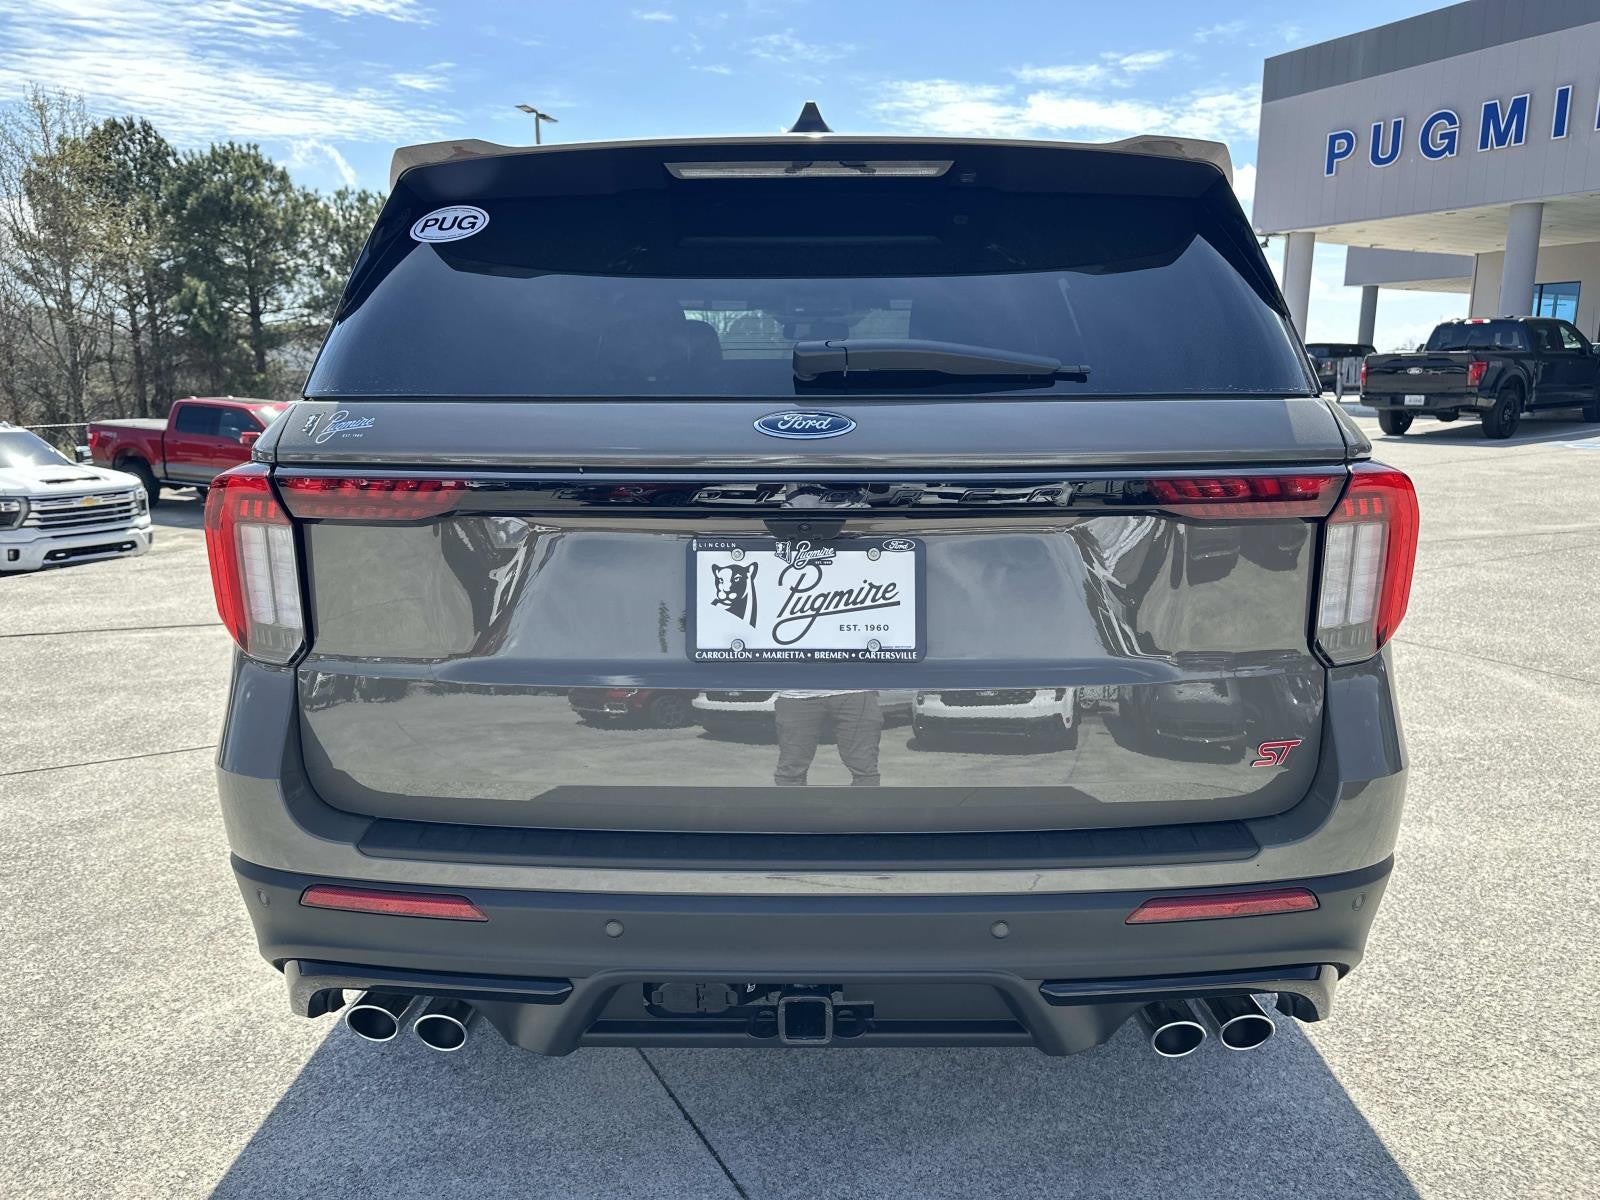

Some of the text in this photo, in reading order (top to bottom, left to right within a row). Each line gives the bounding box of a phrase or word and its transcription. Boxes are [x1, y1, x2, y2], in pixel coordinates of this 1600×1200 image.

[1324, 85, 1600, 177] PUGMI
[420, 214, 479, 234] PUG
[315, 410, 376, 444] Pugmire
[777, 413, 832, 430] Ford
[794, 540, 837, 568] Pugmire
[772, 563, 901, 646] Pugmire
[839, 624, 890, 632] EST. 1960
[695, 651, 918, 660] CARROLLTON MARIETTA BREMEN CARTERSVILLE
[1252, 739, 1302, 768] ST
